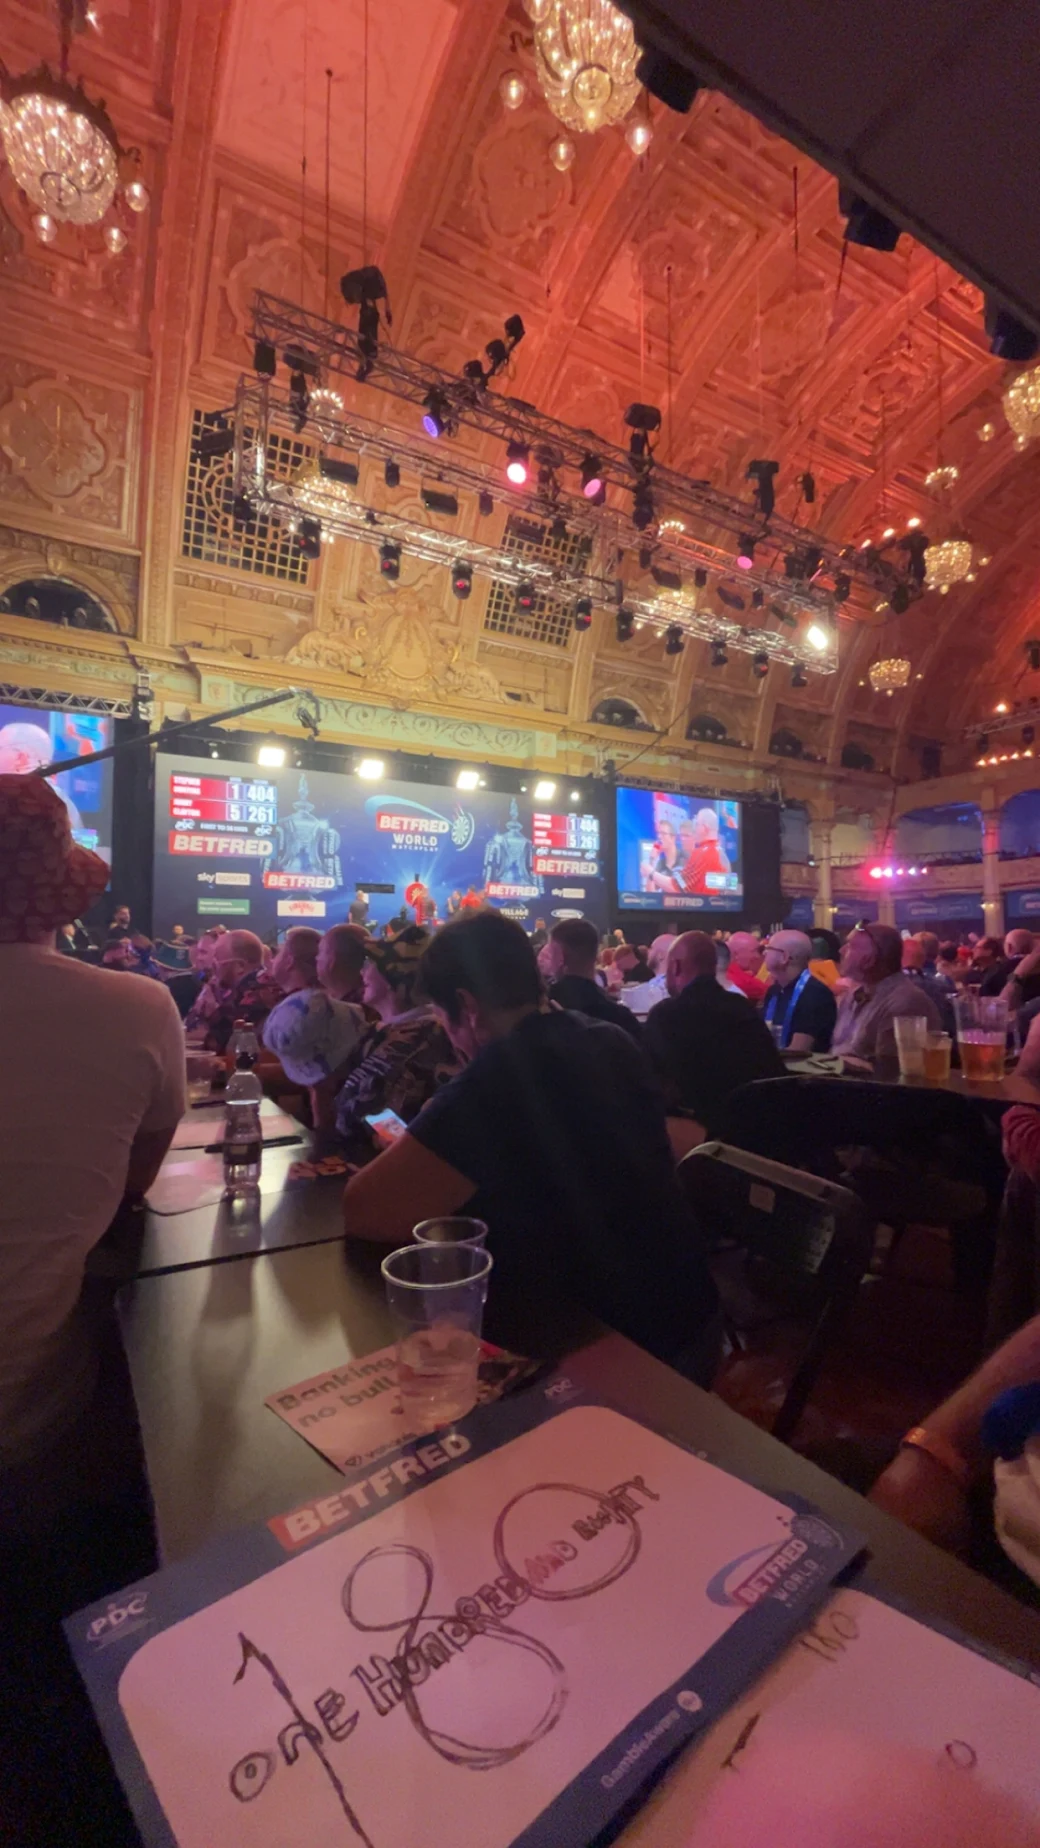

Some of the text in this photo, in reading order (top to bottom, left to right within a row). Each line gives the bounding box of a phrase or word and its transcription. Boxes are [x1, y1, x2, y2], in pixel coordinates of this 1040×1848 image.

[231, 783, 275, 802] 1 404
[230, 804, 274, 825] 5 261
[379, 815, 449, 833] BETFRED
[173, 834, 273, 856] BETFRED
[393, 833, 438, 846] WORLD
[536, 859, 598, 875] BETFRED
[197, 872, 215, 883] sky
[268, 874, 335, 888] BETFRED
[489, 885, 539, 897] BETFRED
[500, 908, 529, 916] VILLAGE
[664, 897, 704, 907] BETFRED
[276, 1356, 397, 1411] Banking
[544, 1377, 573, 1399] PDC
[297, 1372, 399, 1428] no bull
[285, 1433, 471, 1544] BETFRED
[737, 1538, 809, 1603] BETFRED
[773, 1558, 820, 1601] WORLD
[90, 1598, 146, 1636] PDC
